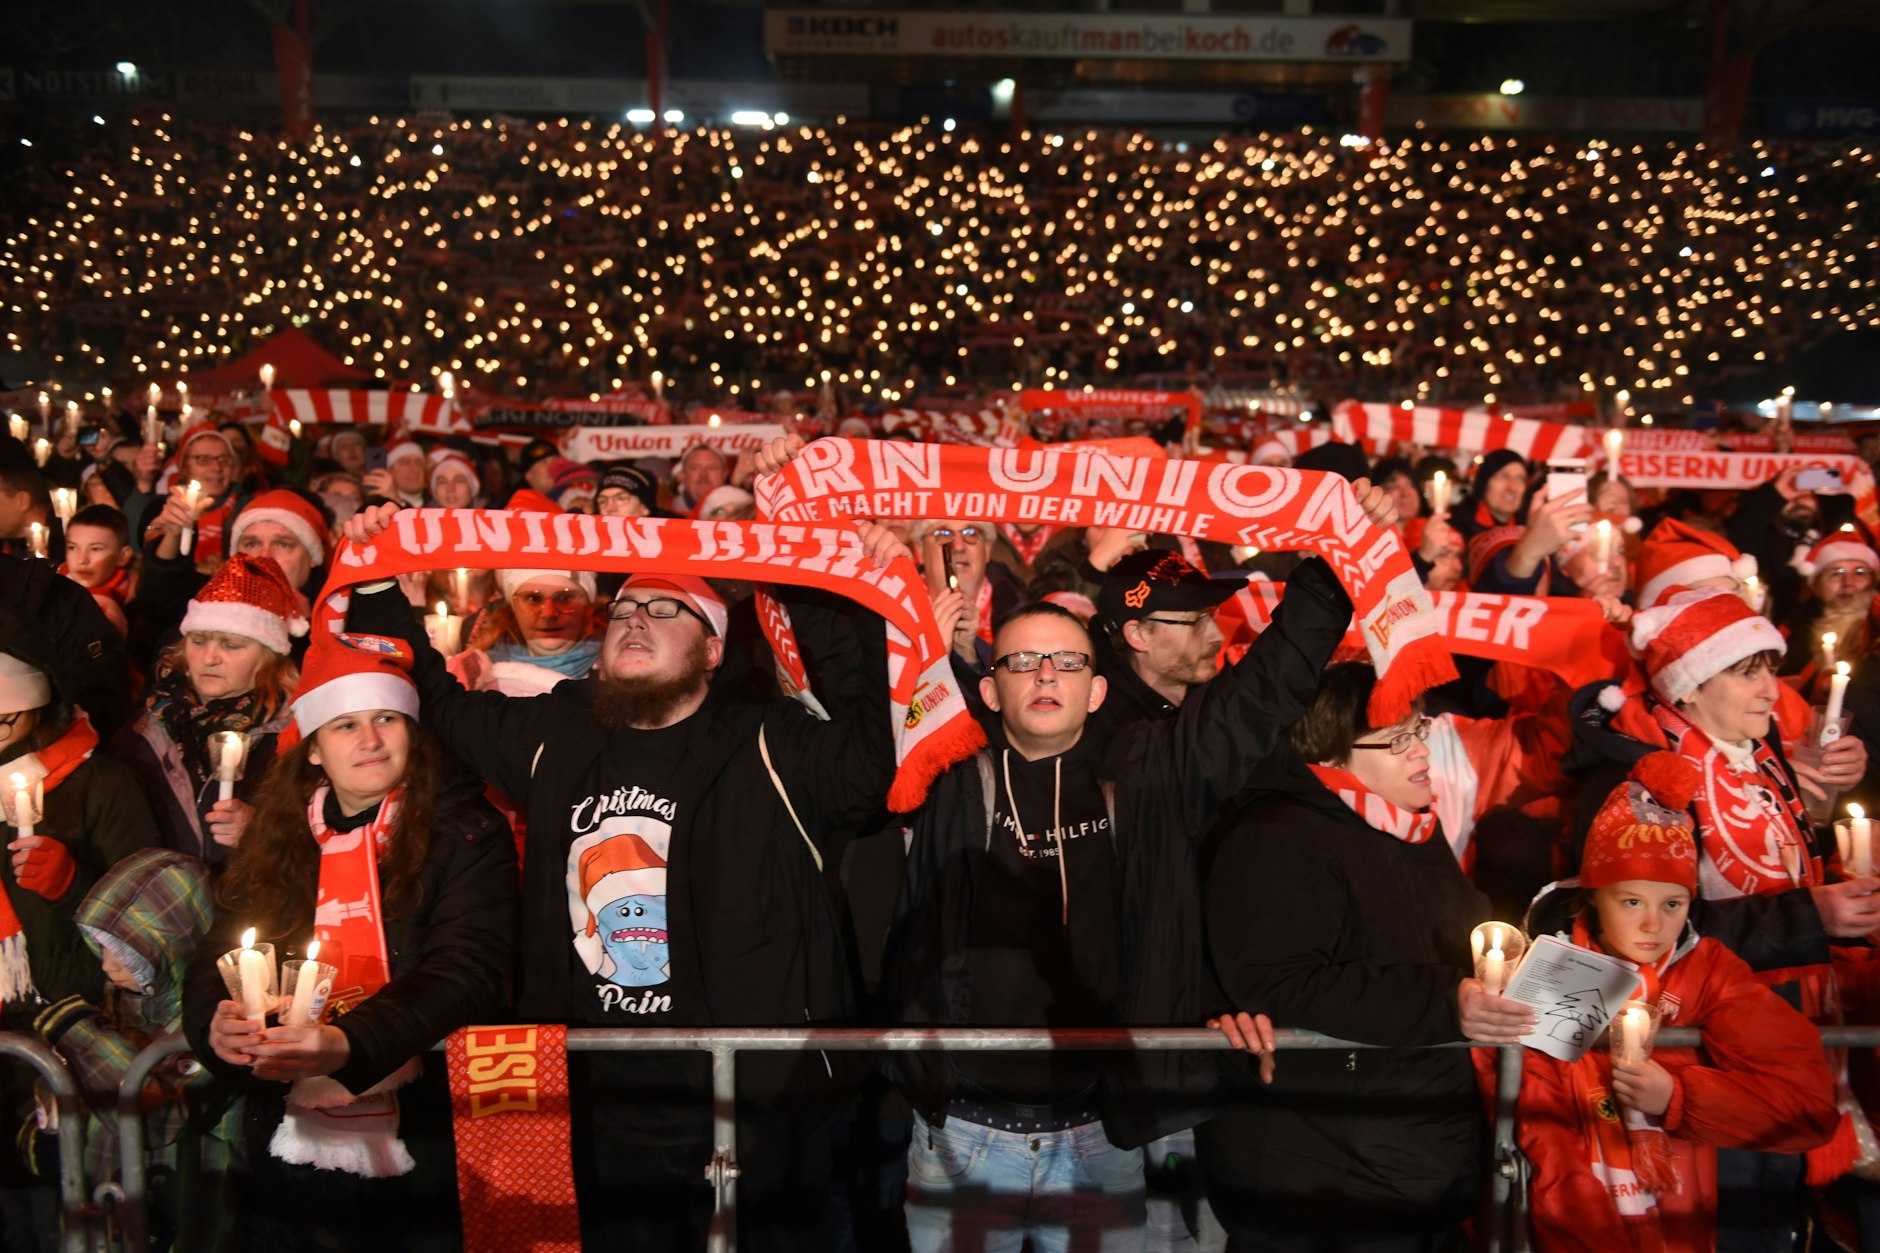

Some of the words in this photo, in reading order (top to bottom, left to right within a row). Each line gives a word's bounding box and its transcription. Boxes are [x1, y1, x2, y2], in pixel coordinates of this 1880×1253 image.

[809, 17, 898, 36] KOCH
[931, 25, 1296, 52] autoskauftmanbeikoch.de
[588, 433, 672, 452] Union
[1619, 453, 1729, 480] EISERN
[827, 491, 932, 519] MACHT
[944, 493, 1006, 518] VON
[1018, 496, 1081, 523] DER
[1093, 500, 1215, 539] WUHLE
[394, 507, 668, 559] UNION
[596, 983, 674, 1015] Pain
[466, 1024, 538, 1119] EISE
